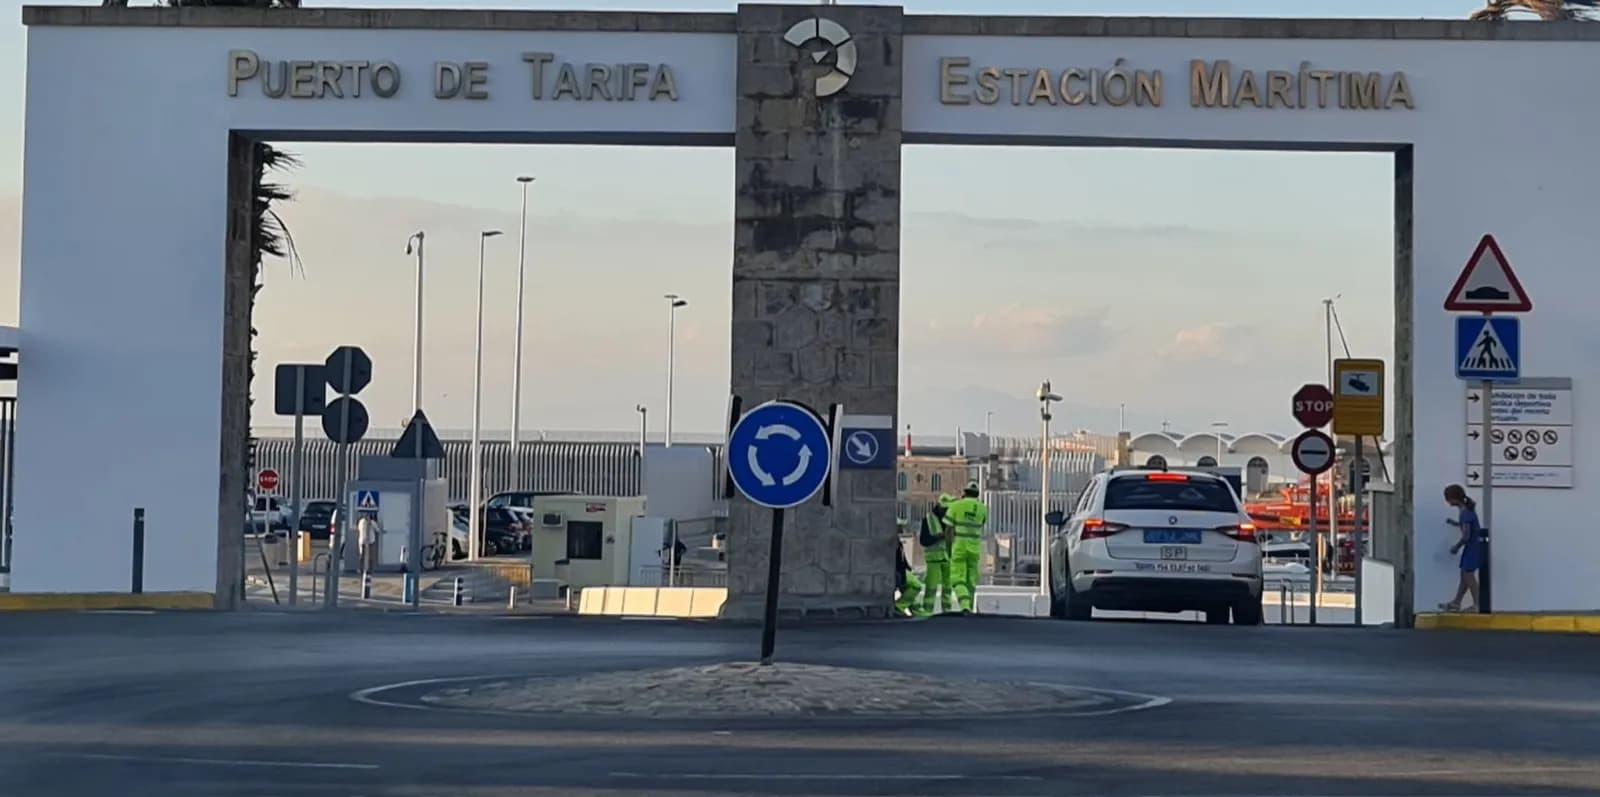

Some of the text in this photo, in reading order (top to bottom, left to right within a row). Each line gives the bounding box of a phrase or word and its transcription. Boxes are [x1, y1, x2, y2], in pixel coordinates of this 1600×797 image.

[228, 50, 678, 101] PUERTO DE TARIFA
[939, 57, 1414, 109] ESTACIÓN MARÍTIMA
[1296, 401, 1334, 412] STOP
